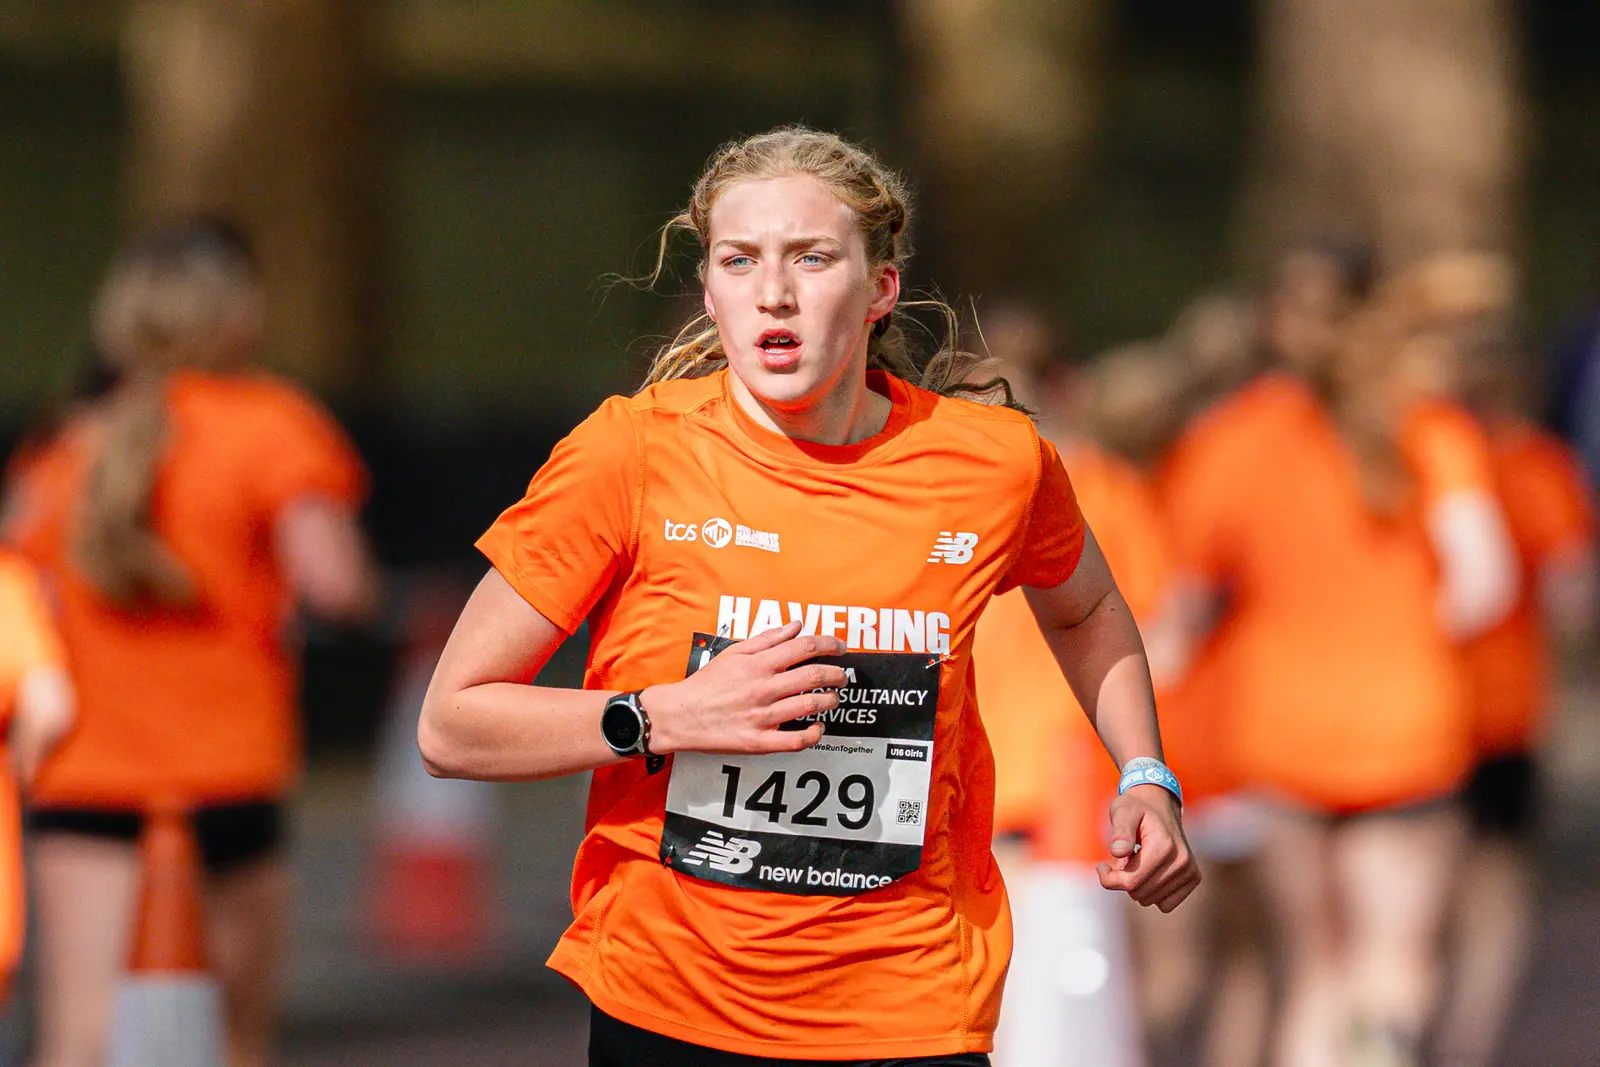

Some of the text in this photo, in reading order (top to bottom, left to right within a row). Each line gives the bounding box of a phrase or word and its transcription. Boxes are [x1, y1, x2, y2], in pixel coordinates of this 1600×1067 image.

[664, 518, 698, 541] tcs
[717, 595, 950, 656] HAVERING
[800, 687, 929, 706] SULTANCY
[808, 743, 874, 754] WeRunTogether
[904, 749, 924, 759] Girls
[721, 764, 875, 830] 1429
[759, 864, 893, 889] new balance
